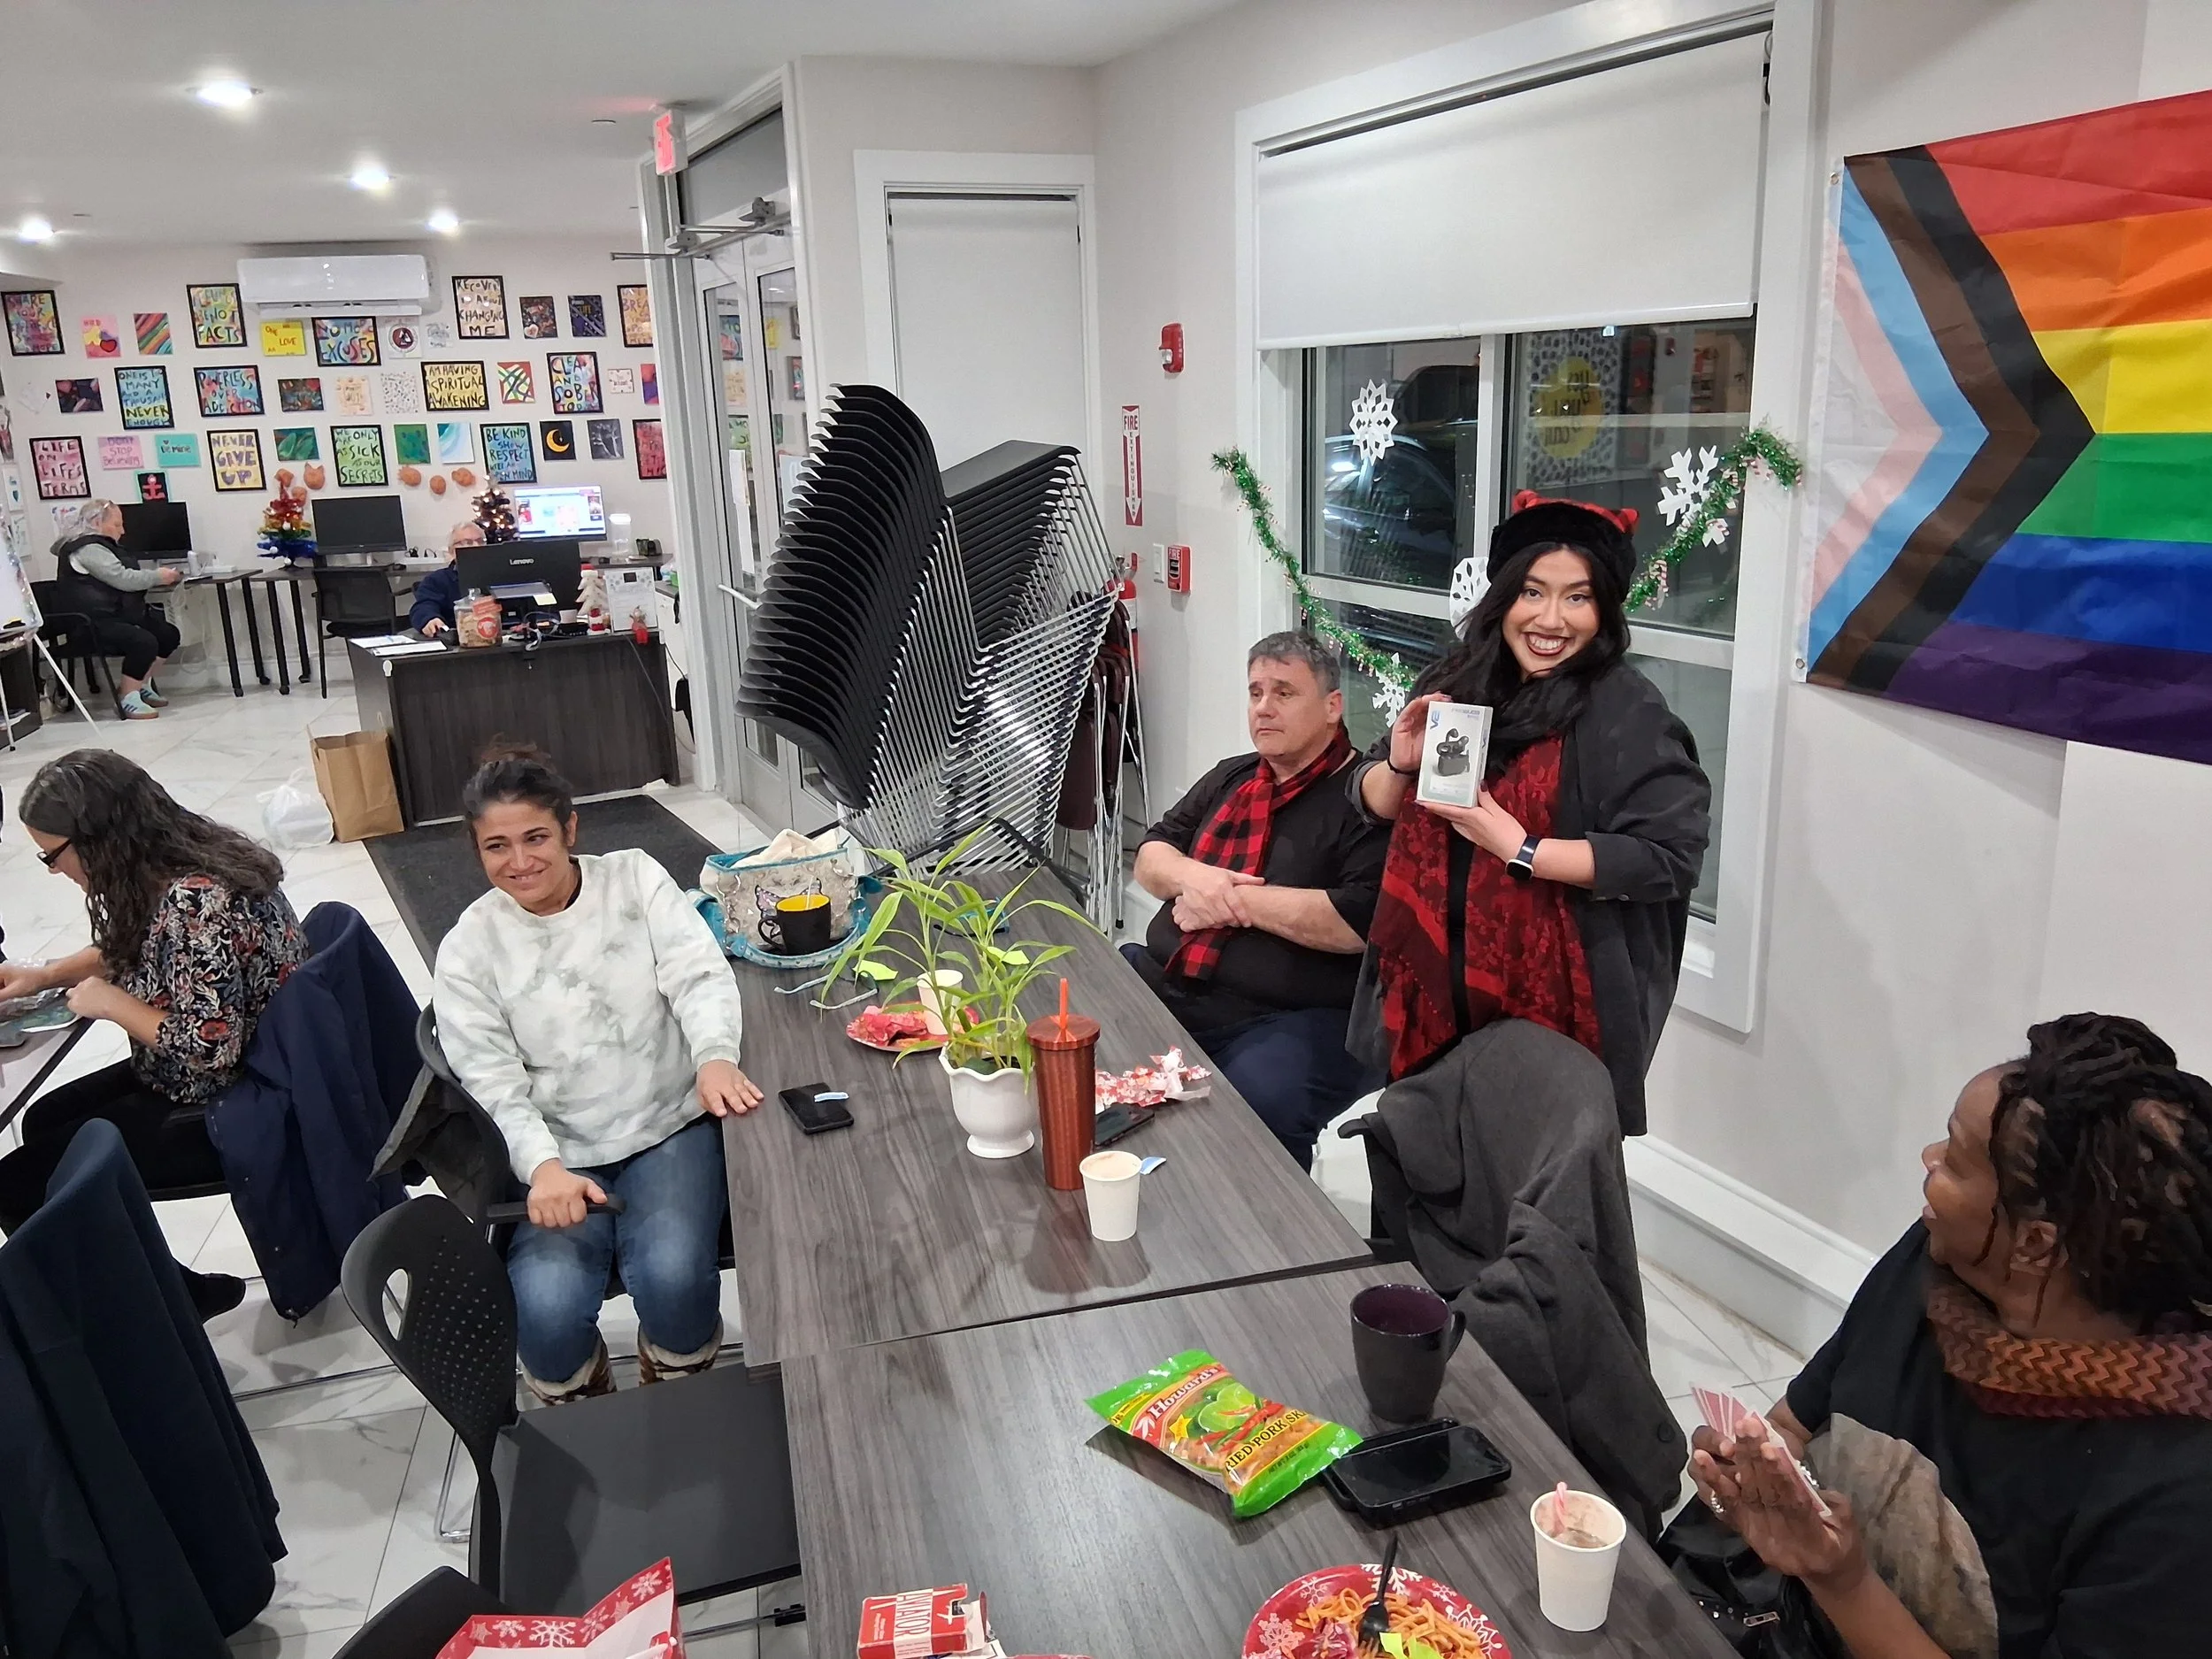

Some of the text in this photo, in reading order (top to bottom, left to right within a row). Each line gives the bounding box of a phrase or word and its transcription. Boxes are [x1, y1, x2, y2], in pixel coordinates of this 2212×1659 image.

[197, 324, 239, 342] FACTS
[469, 325, 496, 335] ME
[319, 336, 376, 363] EXCUSES
[443, 365, 478, 375] HAVING
[126, 379, 159, 390] MANY
[431, 376, 483, 394] SPIRITUAL
[428, 392, 486, 408] AWAKENING
[126, 405, 170, 418] NEVER
[1123, 415, 1138, 430] FIRE
[211, 434, 255, 447] NEVER
[353, 429, 378, 441] ONLY
[486, 427, 526, 442] BE KIND
[42, 441, 77, 452] LIFE
[109, 446, 133, 457] STOP
[349, 443, 380, 459] SICK
[216, 451, 257, 466] GIVE
[489, 449, 528, 462] RESPECT
[221, 470, 252, 487] UP
[341, 465, 383, 483] SECRETS
[512, 467, 533, 480] MIND
[44, 481, 85, 496] TERMS
[1147, 1367, 1219, 1420] Howard's
[1252, 1419, 1287, 1448] PORK
[895, 1594, 932, 1637] AVIATOR
